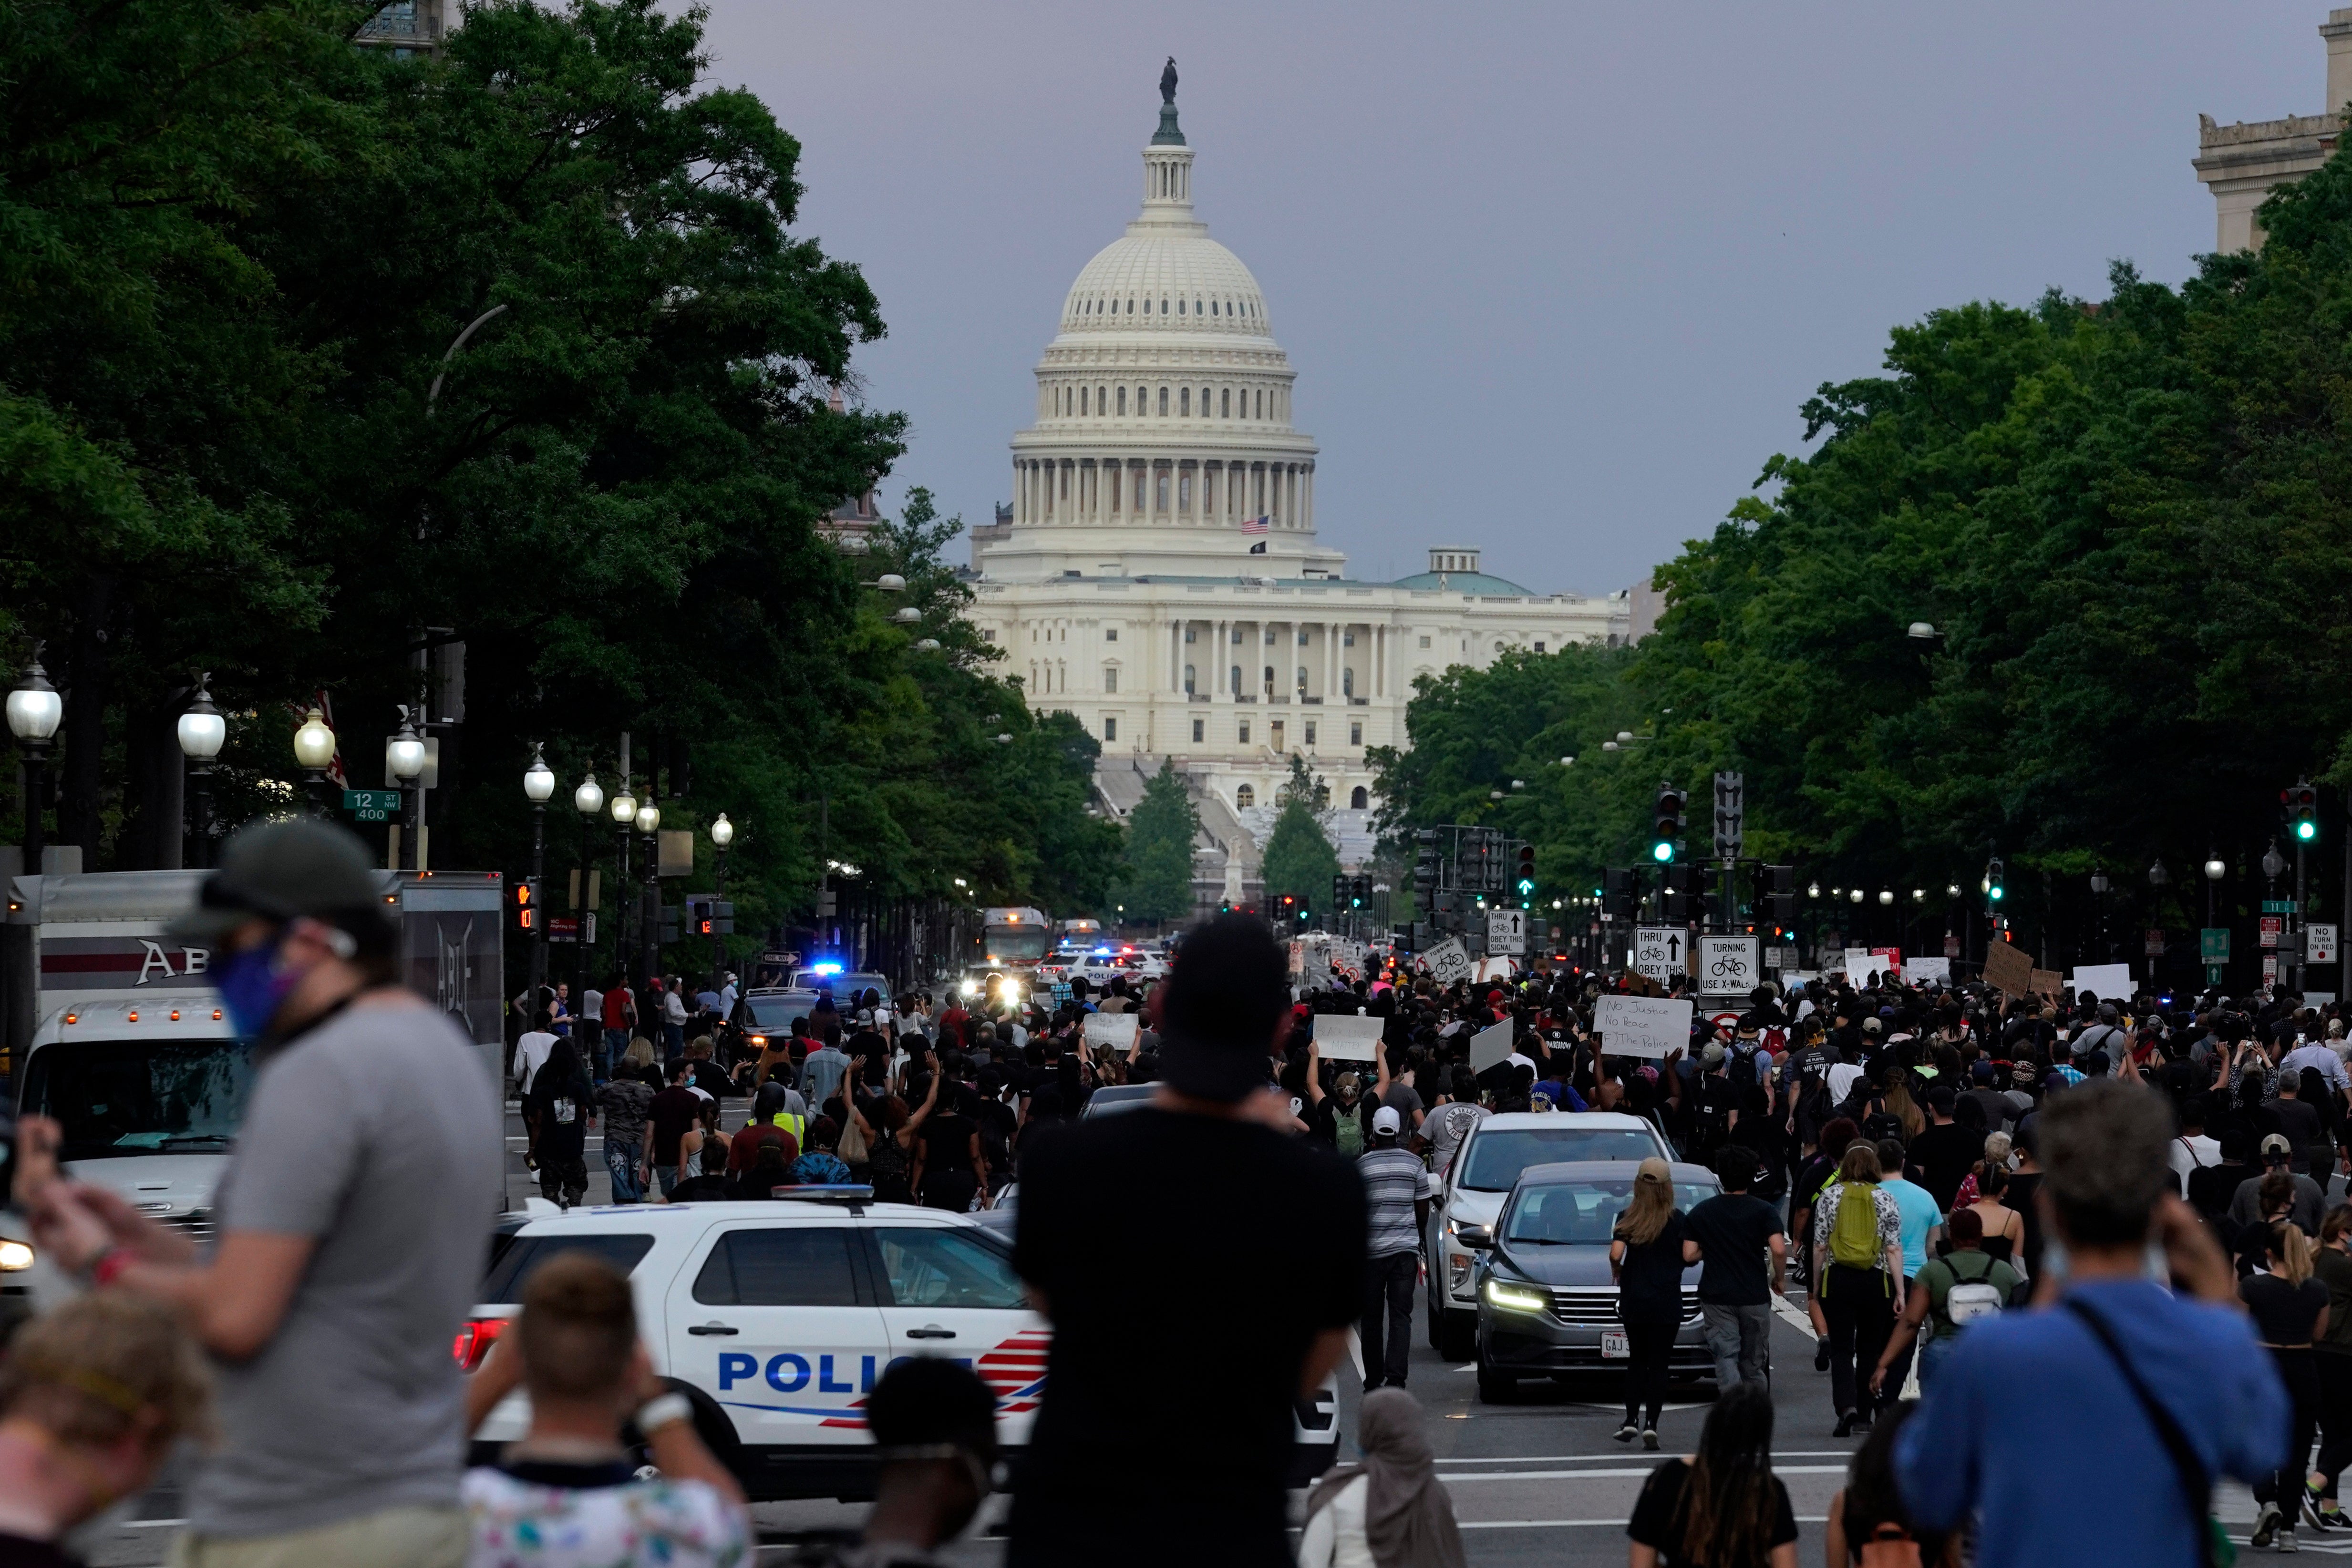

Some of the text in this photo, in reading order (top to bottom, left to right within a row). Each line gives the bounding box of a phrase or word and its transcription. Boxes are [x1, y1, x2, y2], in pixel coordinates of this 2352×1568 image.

[354, 793, 372, 807] 12
[359, 809, 385, 820] 400
[2271, 902, 2279, 912] 11
[521, 909, 531, 928] 10
[1640, 933, 1662, 942] THRU
[1430, 941, 1454, 957] TURNING
[1712, 943, 1746, 953] TURNING
[134, 937, 210, 986] AB
[1639, 964, 1683, 975] OBEY THIS
[1703, 980, 1719, 989] USE
[1629, 1001, 1668, 1015] Justice
[1623, 1016, 1650, 1028] Peace
[1640, 1035, 1670, 1048] Police
[1803, 1065, 1813, 1073] WE
[1446, 1108, 1477, 1122] NEW ORLEA
[1606, 1339, 1622, 1351] GAJ
